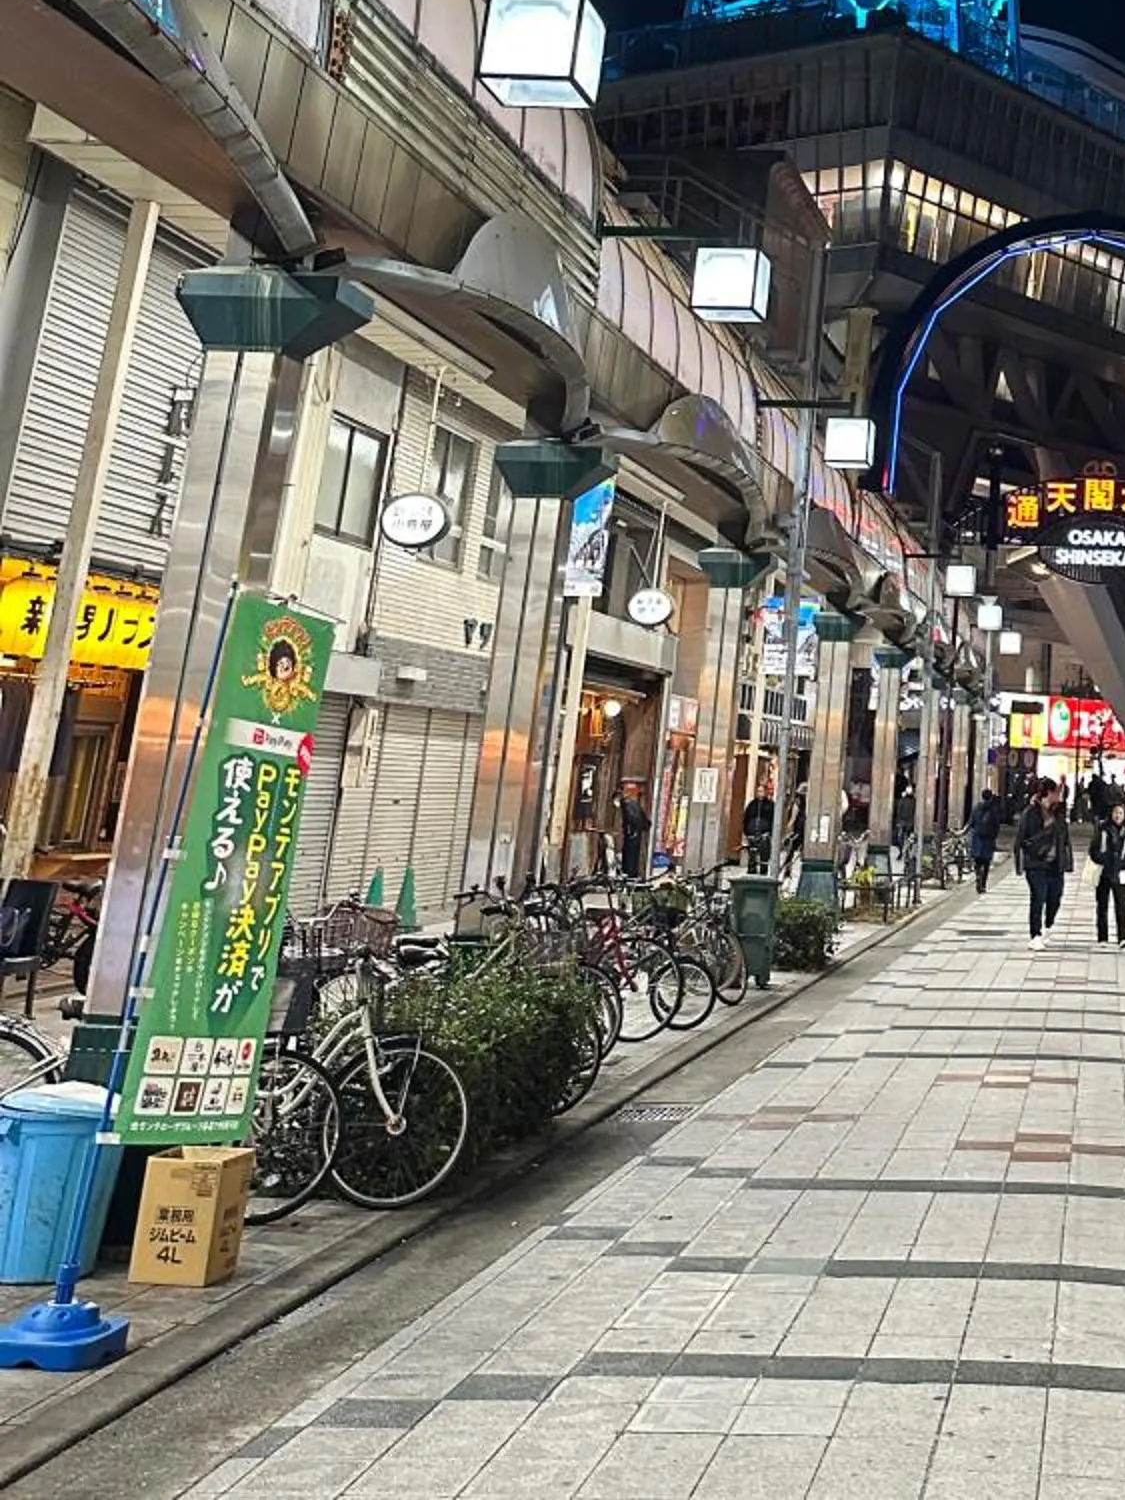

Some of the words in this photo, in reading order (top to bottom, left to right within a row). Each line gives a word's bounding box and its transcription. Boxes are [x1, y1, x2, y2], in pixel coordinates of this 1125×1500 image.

[210, 763, 277, 1013] PayPay決済が
[251, 769, 301, 990] モンテアプリで
[158, 1208, 195, 1223] 業務用
[149, 1227, 196, 1244] ジムビーム
[156, 1246, 182, 1264] 4L
